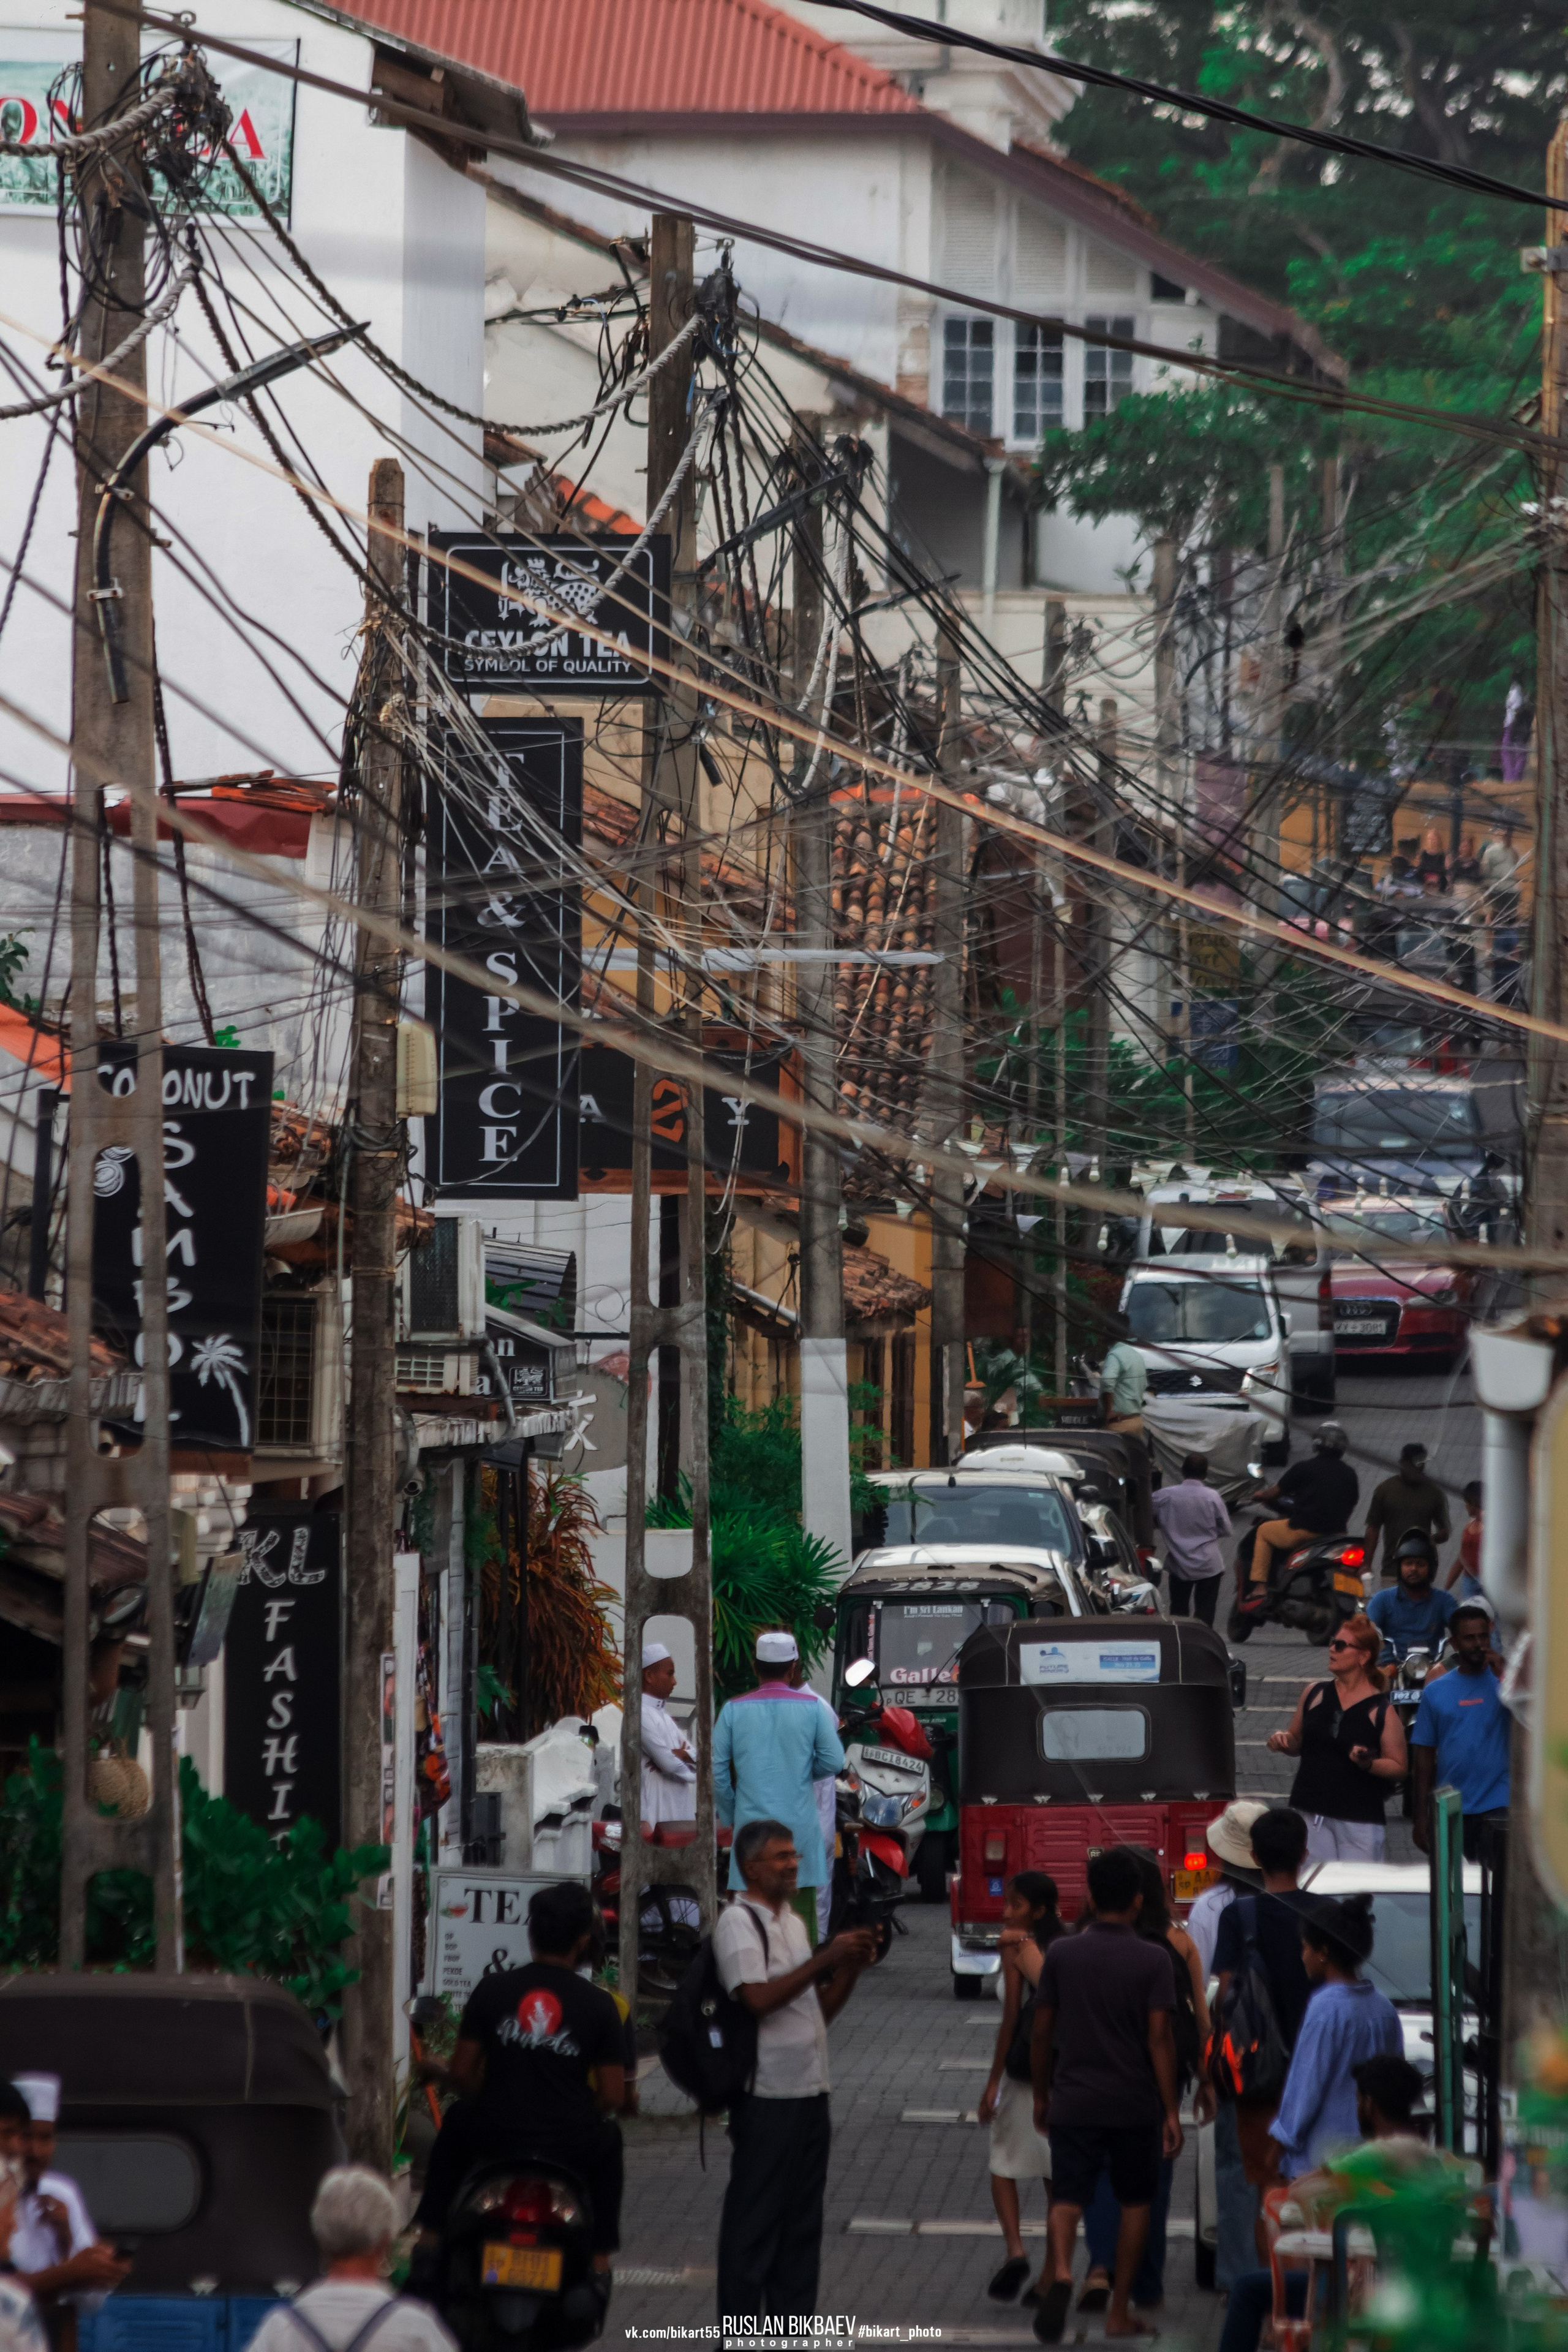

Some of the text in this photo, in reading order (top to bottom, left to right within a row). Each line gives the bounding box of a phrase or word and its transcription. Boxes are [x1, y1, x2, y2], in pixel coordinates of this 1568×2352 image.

[464, 630, 632, 658] CEYLON TEA
[464, 658, 633, 674] SYMBOL OF QUALITY
[477, 753, 526, 1163] TEA & SPICE
[97, 1065, 255, 1110] OONUT
[237, 1527, 327, 1588] KL
[883, 1581, 980, 1592] 2828
[903, 1605, 963, 1615] I'm Sri Lankan
[889, 1667, 951, 1684] Galle
[464, 1888, 529, 1926] TE
